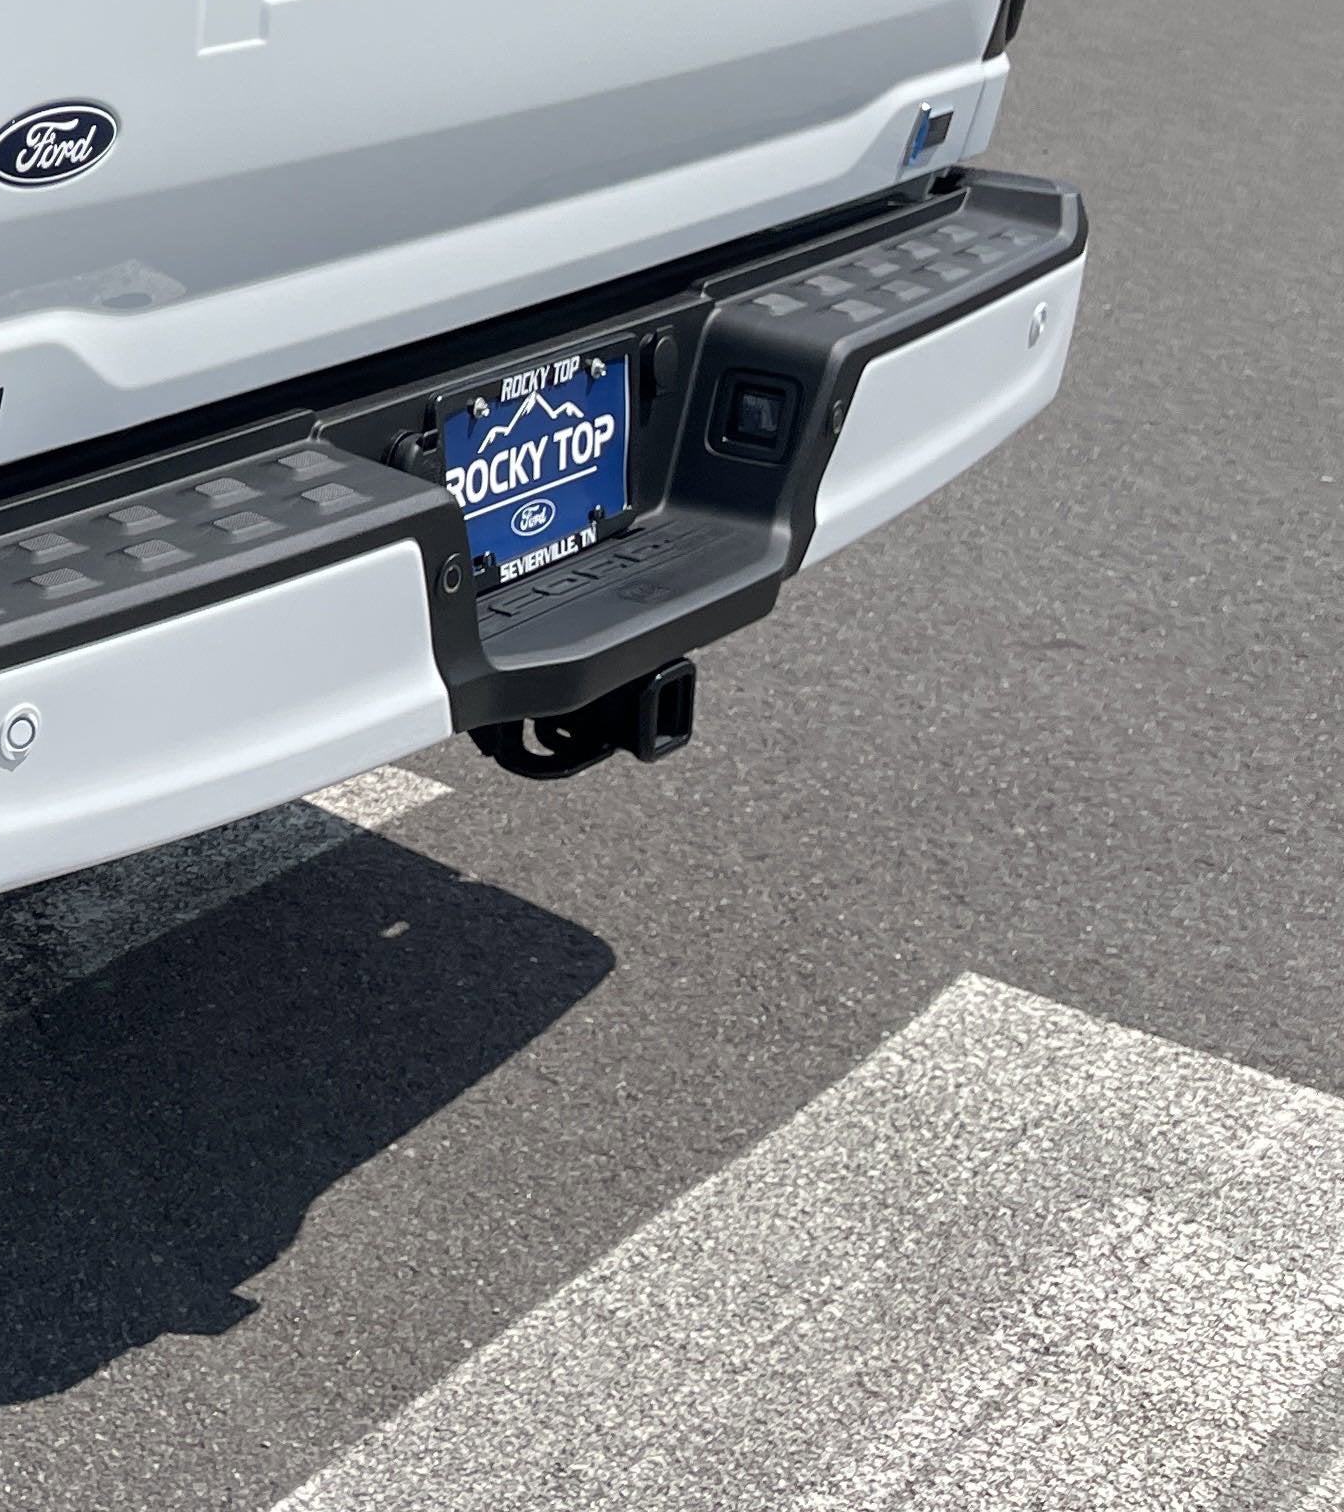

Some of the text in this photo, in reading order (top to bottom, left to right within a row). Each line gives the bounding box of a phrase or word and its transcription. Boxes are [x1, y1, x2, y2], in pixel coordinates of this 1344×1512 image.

[15, 118, 97, 173] Ford
[501, 355, 580, 402] ROCKY TOP
[553, 414, 615, 471] TOP
[520, 505, 547, 531] Ford
[500, 524, 598, 584] SEVIERVILLE, TN
